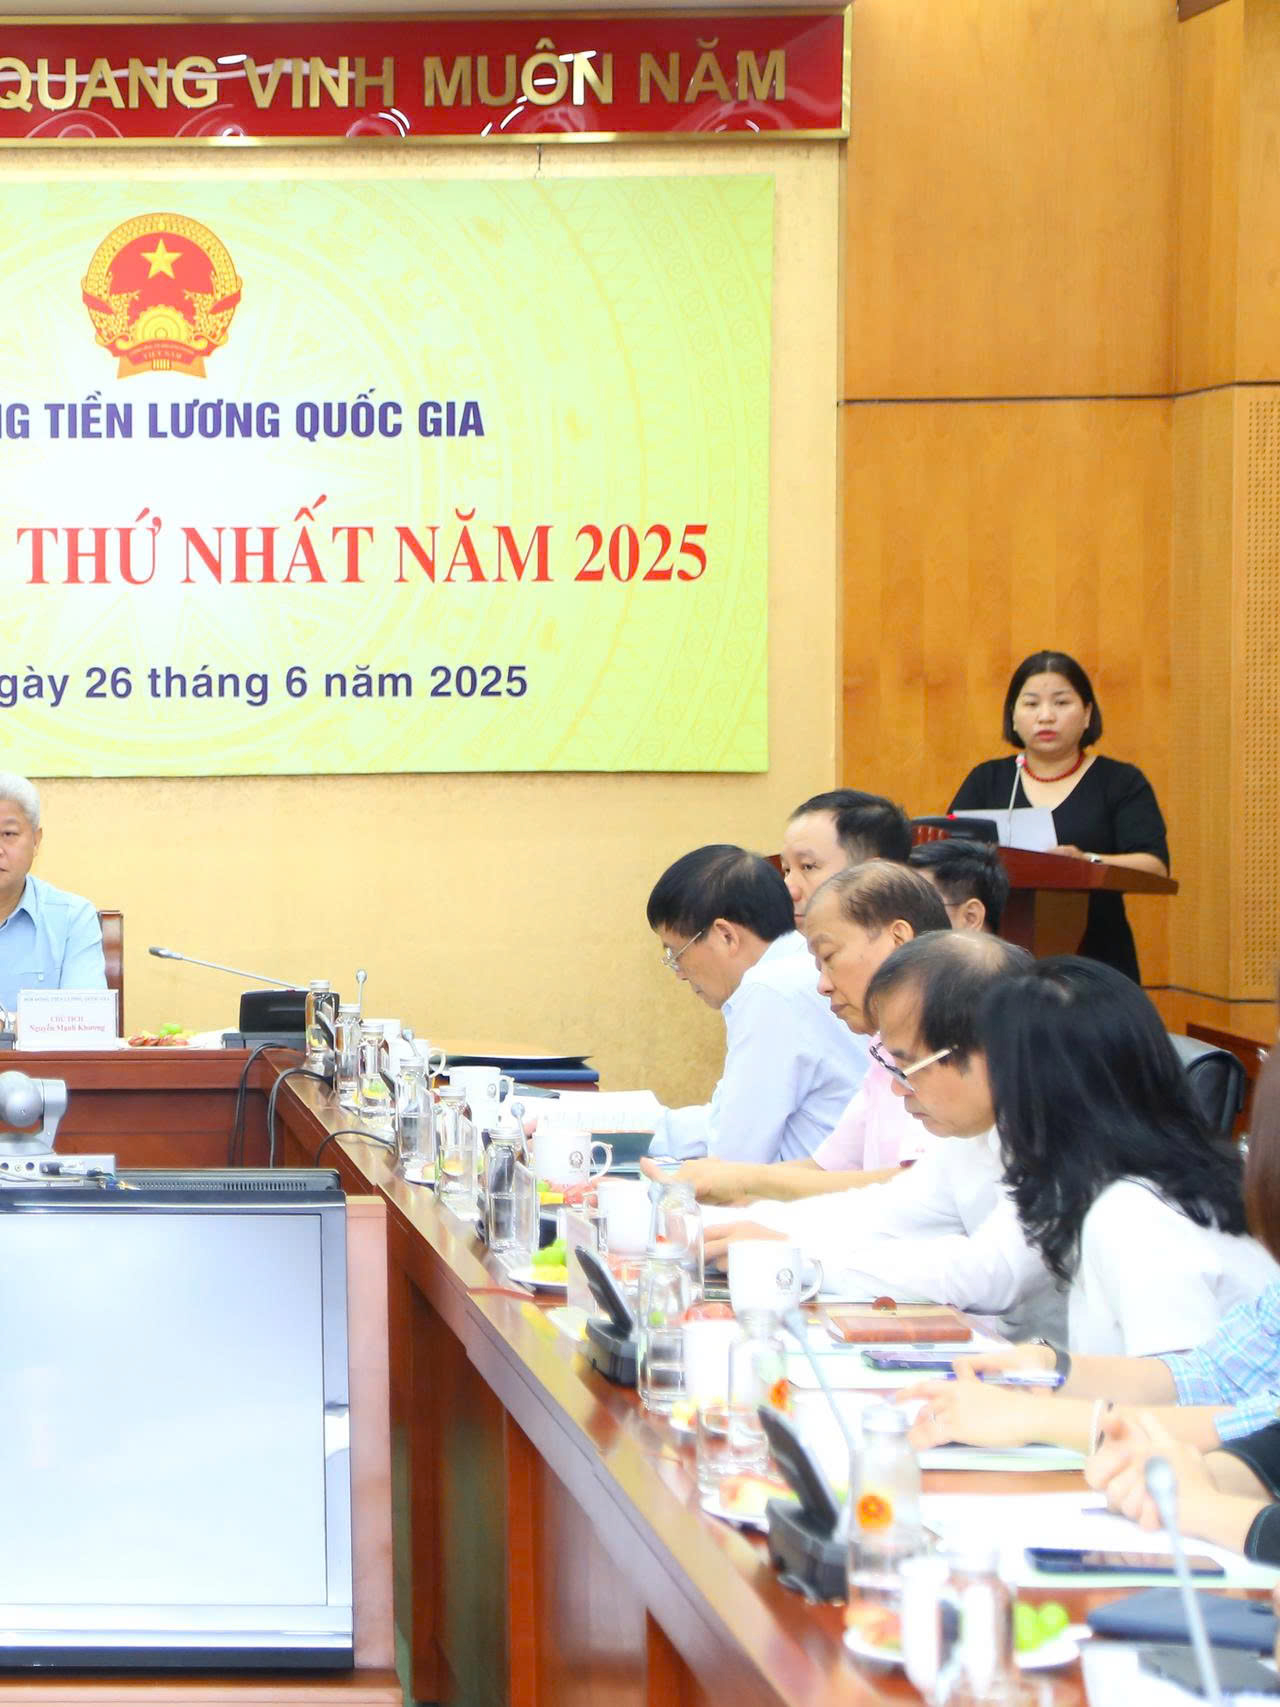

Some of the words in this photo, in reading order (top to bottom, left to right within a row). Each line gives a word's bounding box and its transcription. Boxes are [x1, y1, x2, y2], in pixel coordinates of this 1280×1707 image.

[244, 56, 395, 108] VINH
[424, 38, 614, 105] MUÔN
[639, 38, 787, 104] NĂM
[45, 391, 132, 438] TIỀN
[149, 399, 280, 439] LƯƠNG
[295, 389, 402, 441] QUỐC
[419, 402, 484, 438] GIA
[17, 509, 162, 584] THỨ
[182, 494, 374, 583] NHẤT
[395, 508, 551, 582] NĂM
[575, 525, 708, 582] 2025
[86, 667, 132, 699] 26
[148, 665, 268, 707] tháng
[285, 667, 308, 698] 6
[325, 666, 412, 698] năm
[430, 666, 528, 698] 2025
